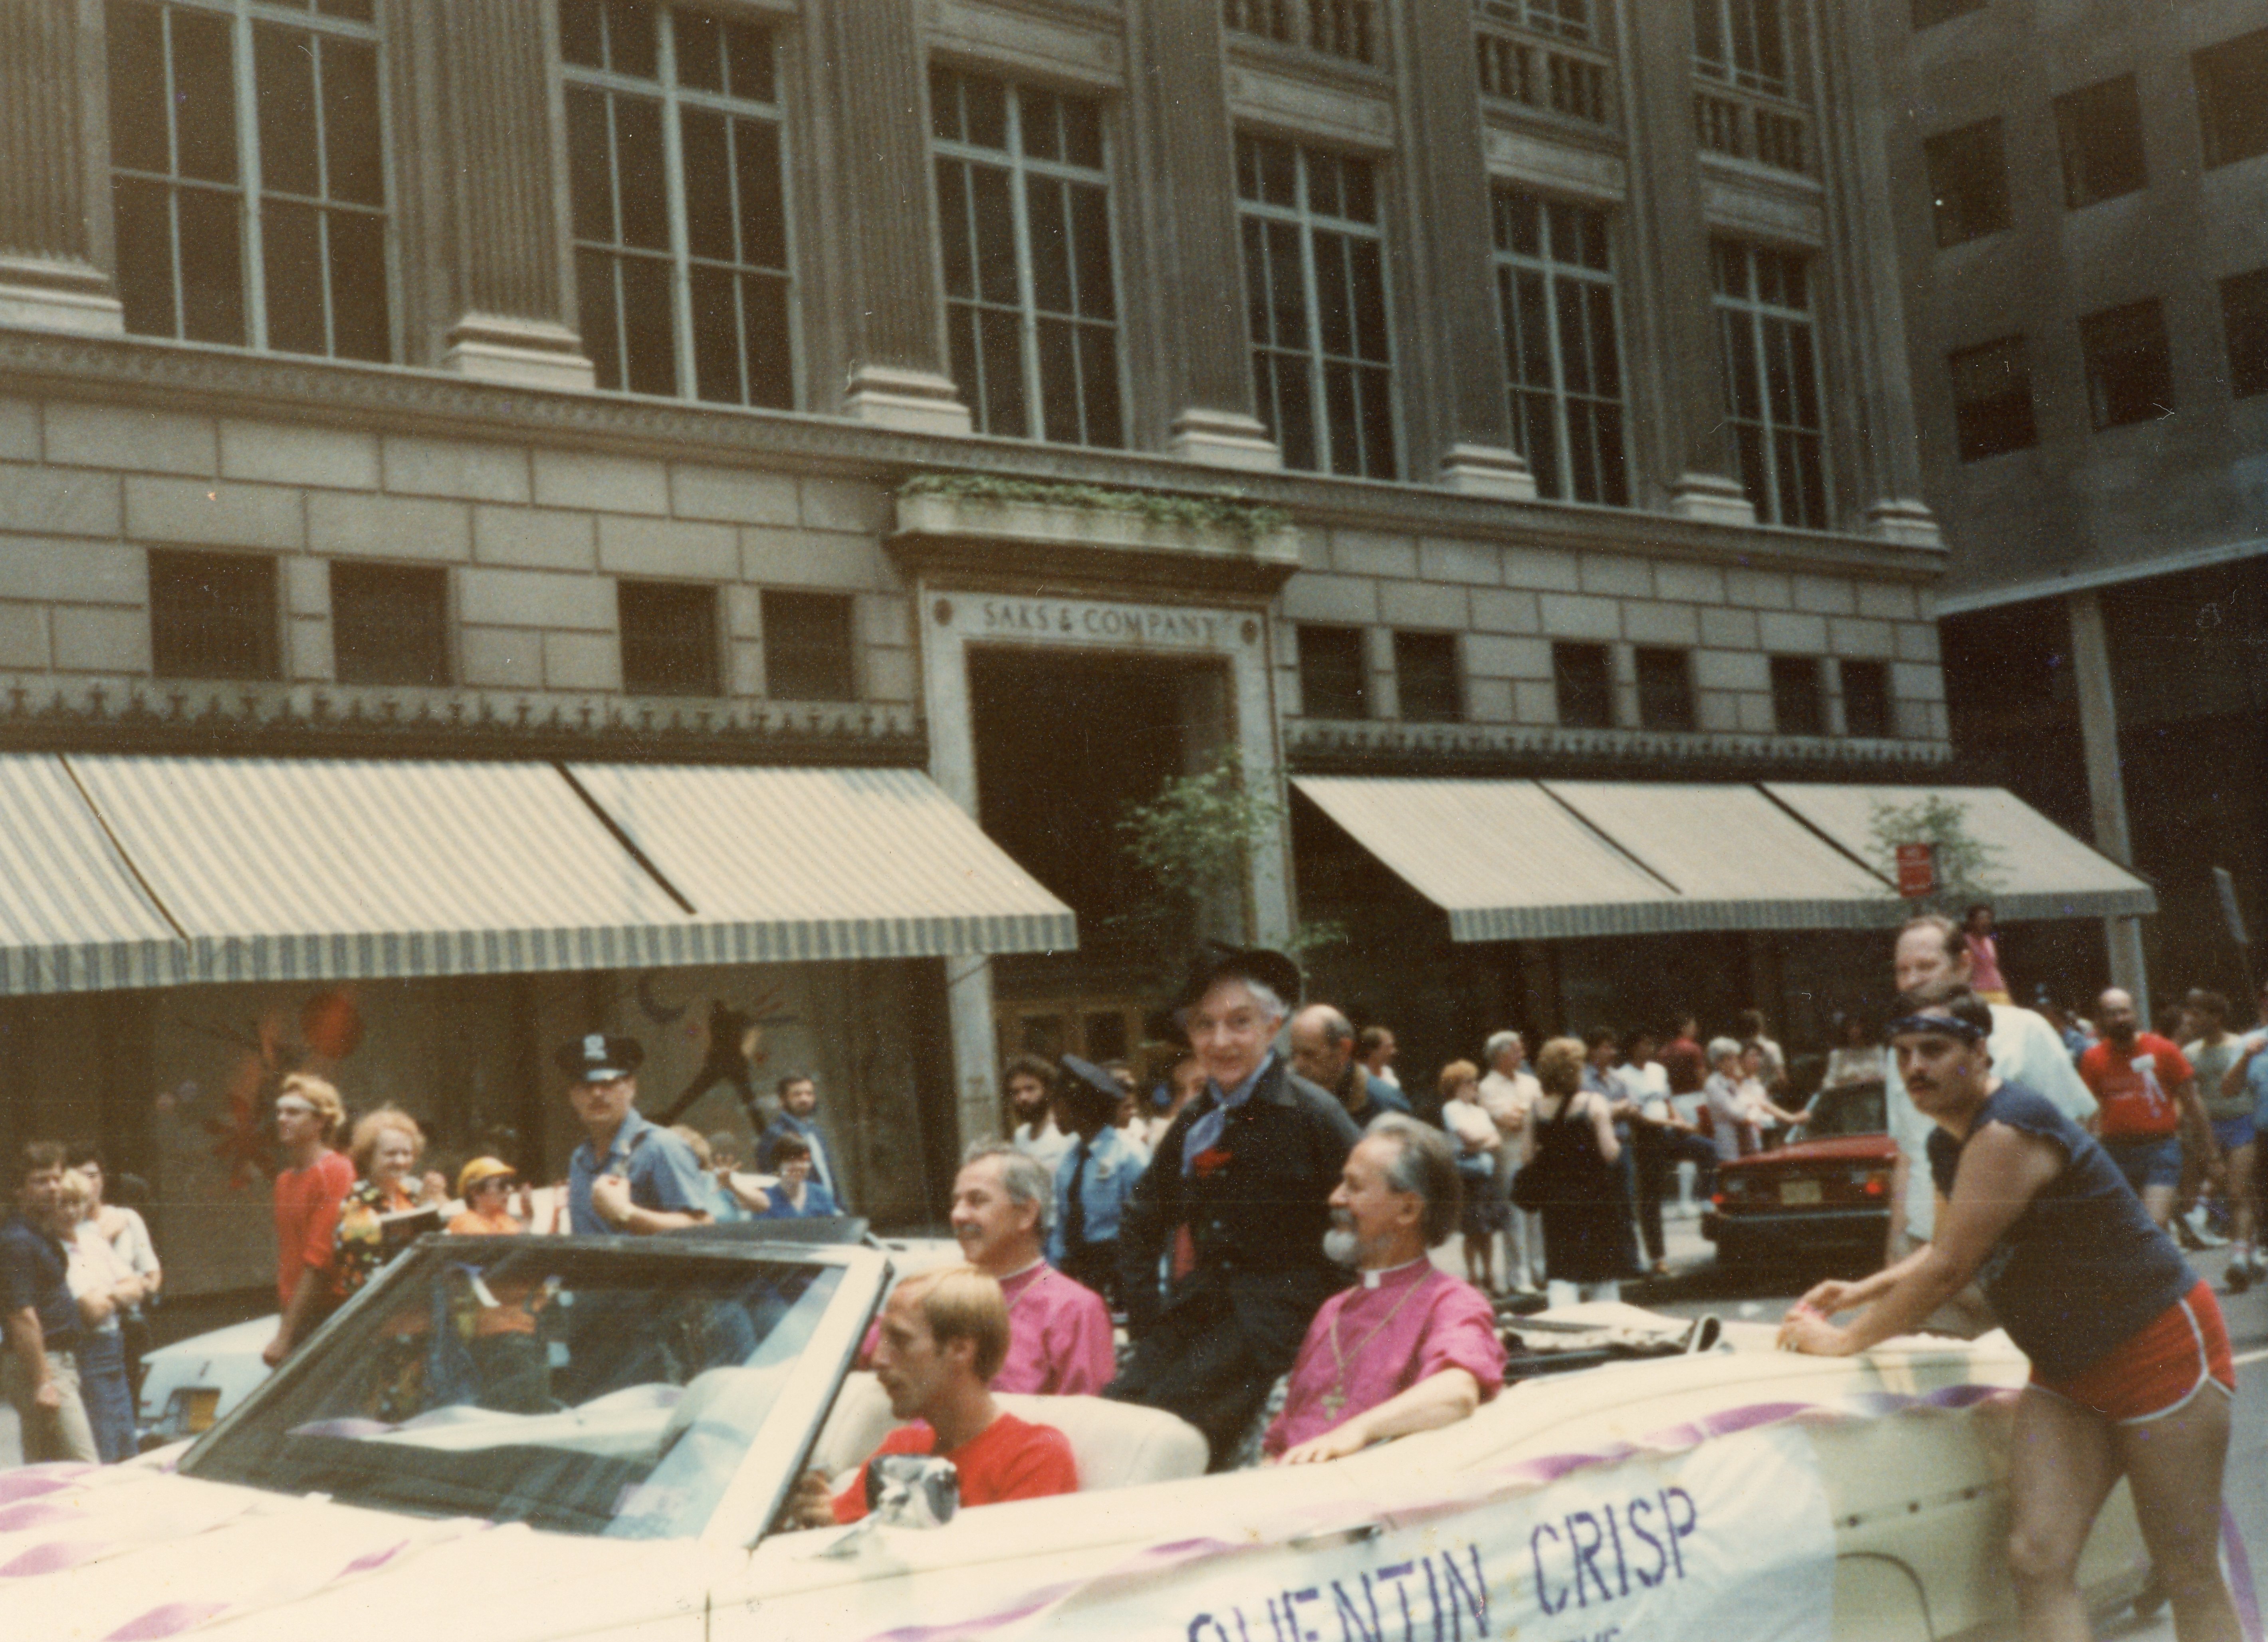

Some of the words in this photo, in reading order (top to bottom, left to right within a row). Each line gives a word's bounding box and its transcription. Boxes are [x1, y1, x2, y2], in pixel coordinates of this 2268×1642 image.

[983, 601, 1050, 631] SAKS
[1060, 607, 1073, 632] &
[1082, 609, 1216, 641] COMPANY
[1531, 1487, 1697, 1616] CRISP
